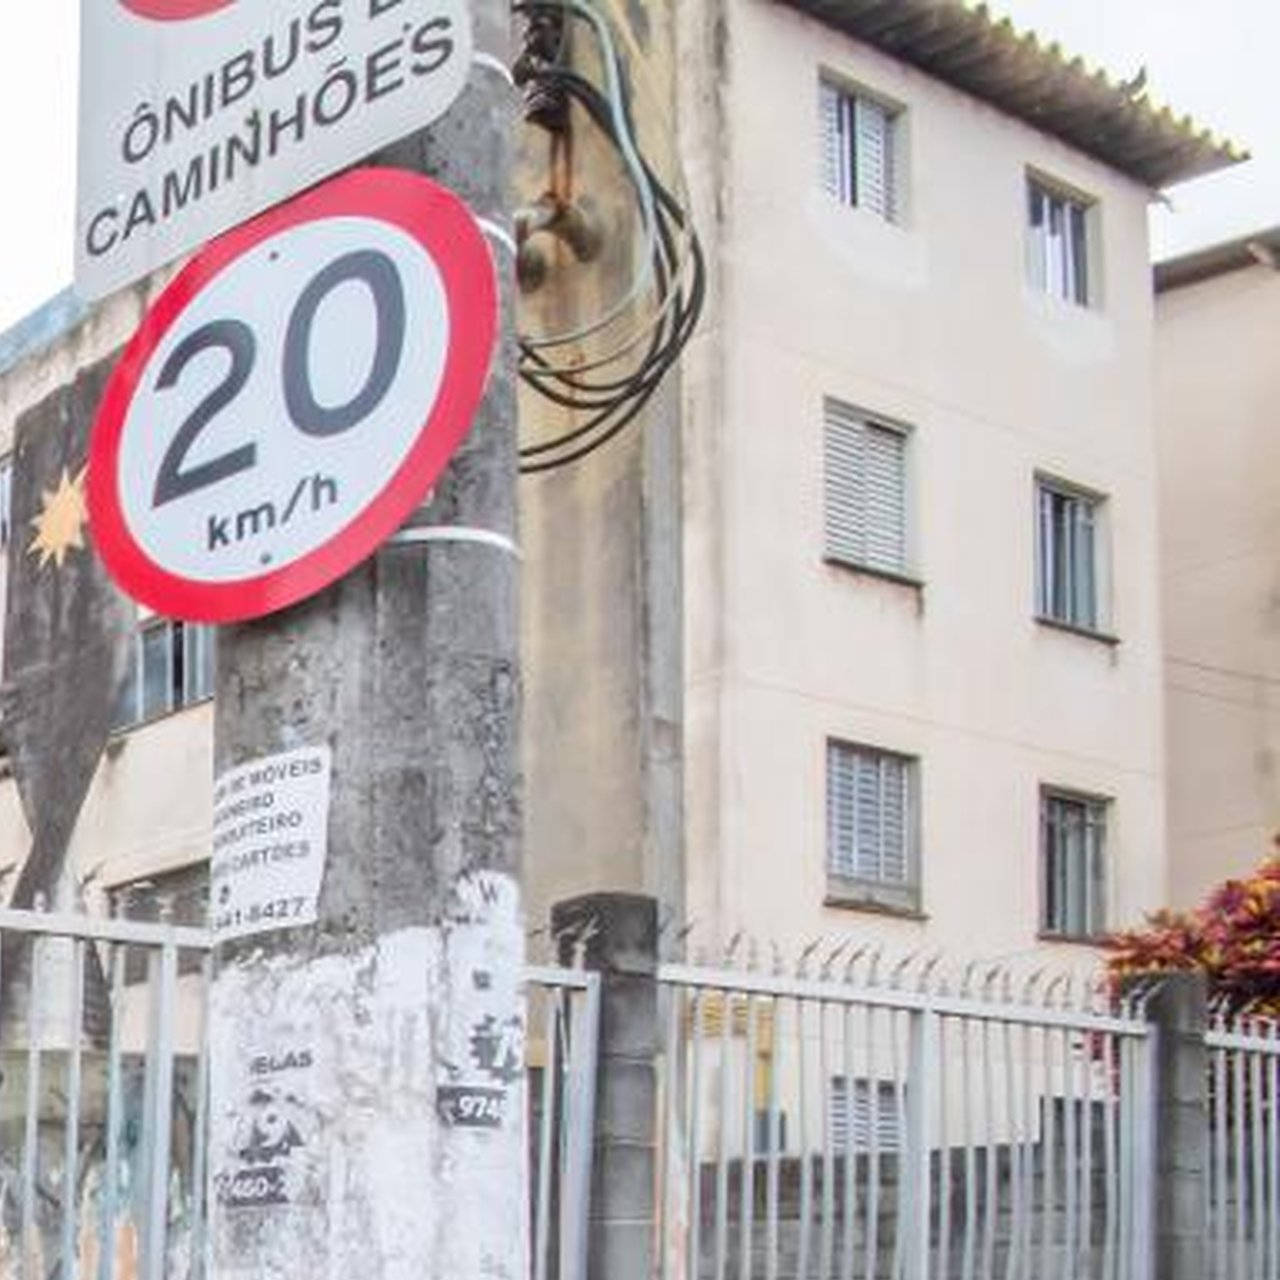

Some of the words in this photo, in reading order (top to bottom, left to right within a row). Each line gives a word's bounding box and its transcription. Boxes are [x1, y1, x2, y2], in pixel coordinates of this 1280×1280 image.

[85, 17, 455, 257] CAMINHÕES
[121, 0, 342, 165] ÔNIBUS
[152, 249, 406, 508] 20
[206, 473, 339, 551] km/h
